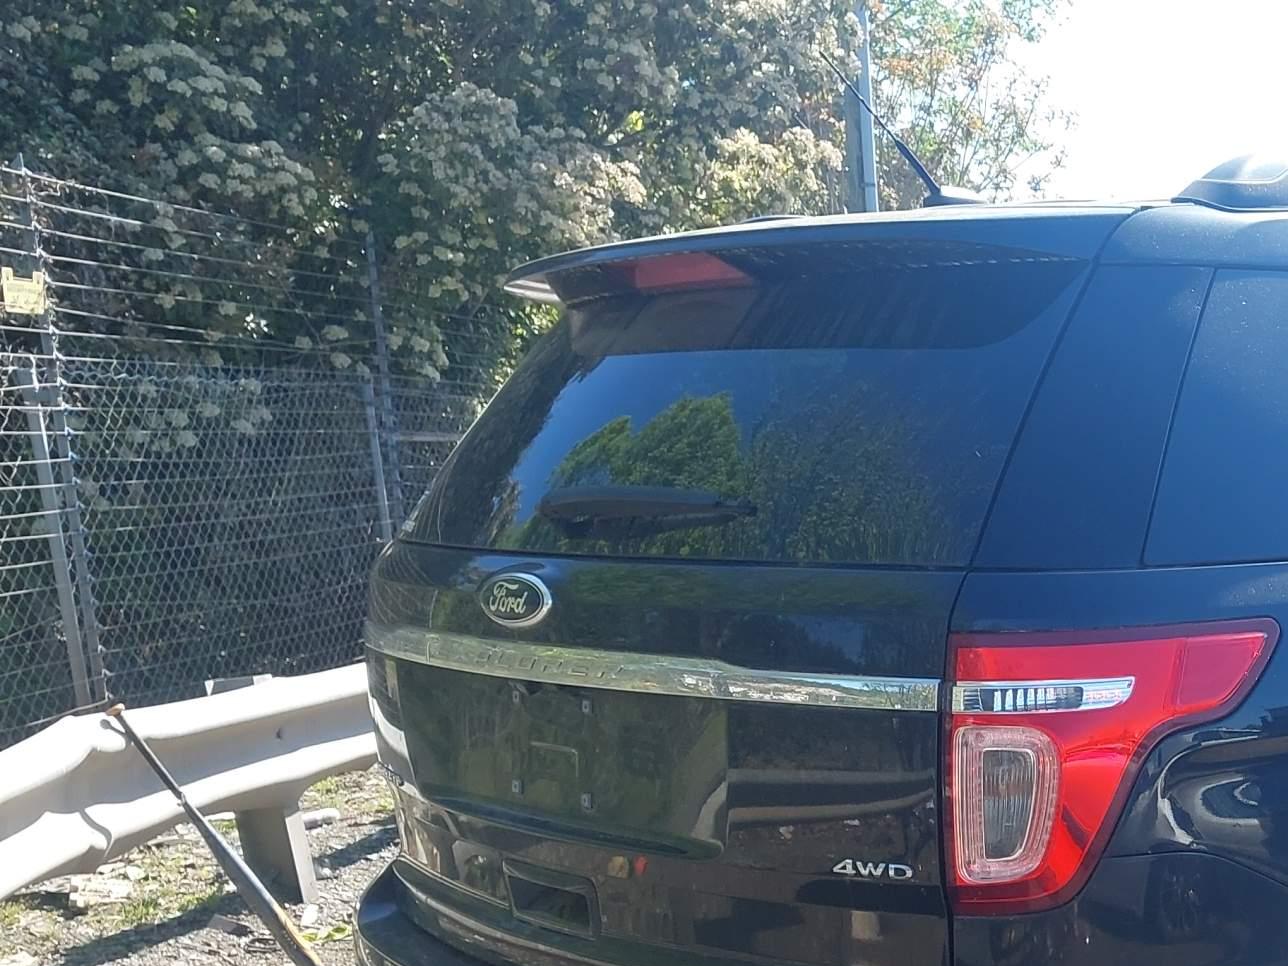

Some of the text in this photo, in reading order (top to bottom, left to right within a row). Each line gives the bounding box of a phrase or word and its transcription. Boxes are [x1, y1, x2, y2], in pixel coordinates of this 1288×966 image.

[488, 581, 529, 614] Ford
[432, 642, 625, 680] PLORER
[832, 858, 913, 880] 4WD
